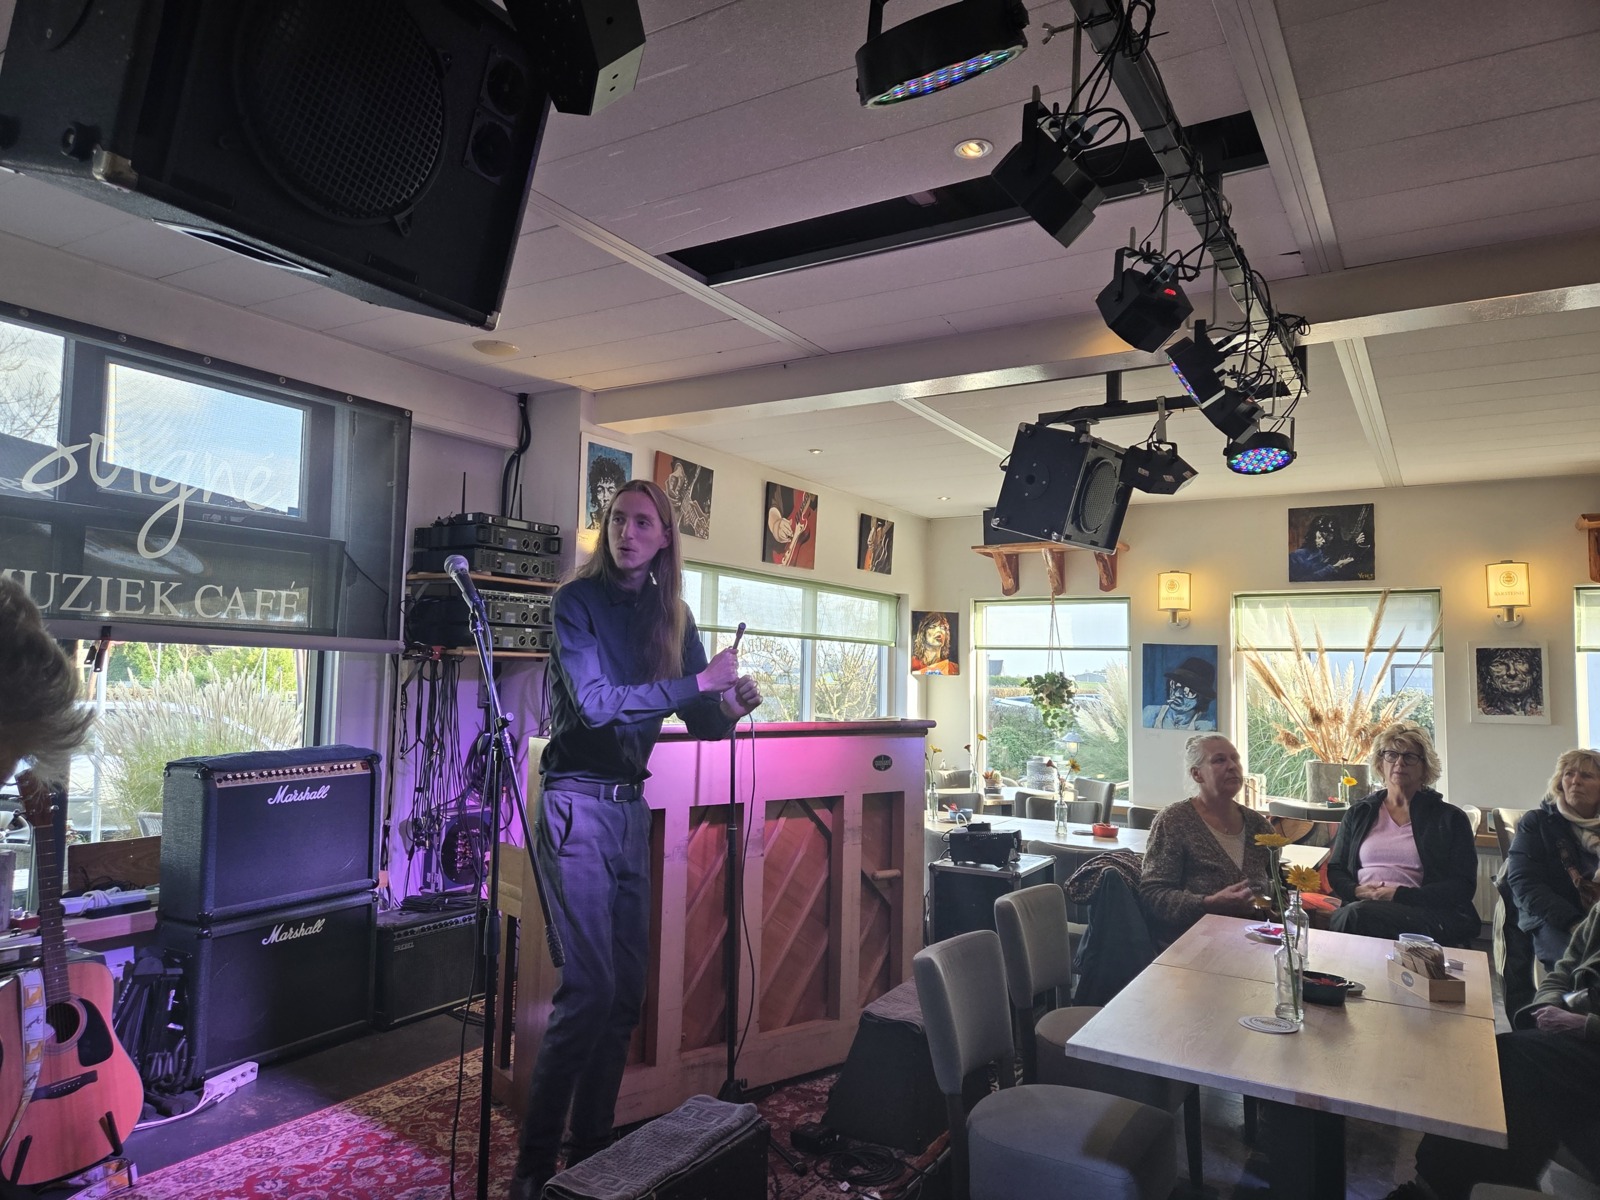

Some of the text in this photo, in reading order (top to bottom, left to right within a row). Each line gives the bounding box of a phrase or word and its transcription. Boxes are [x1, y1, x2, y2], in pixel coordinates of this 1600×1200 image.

[0, 568, 300, 621] UZIEK CAFÉ
[267, 784, 331, 805] Marshall
[261, 918, 326, 945] Marshall
